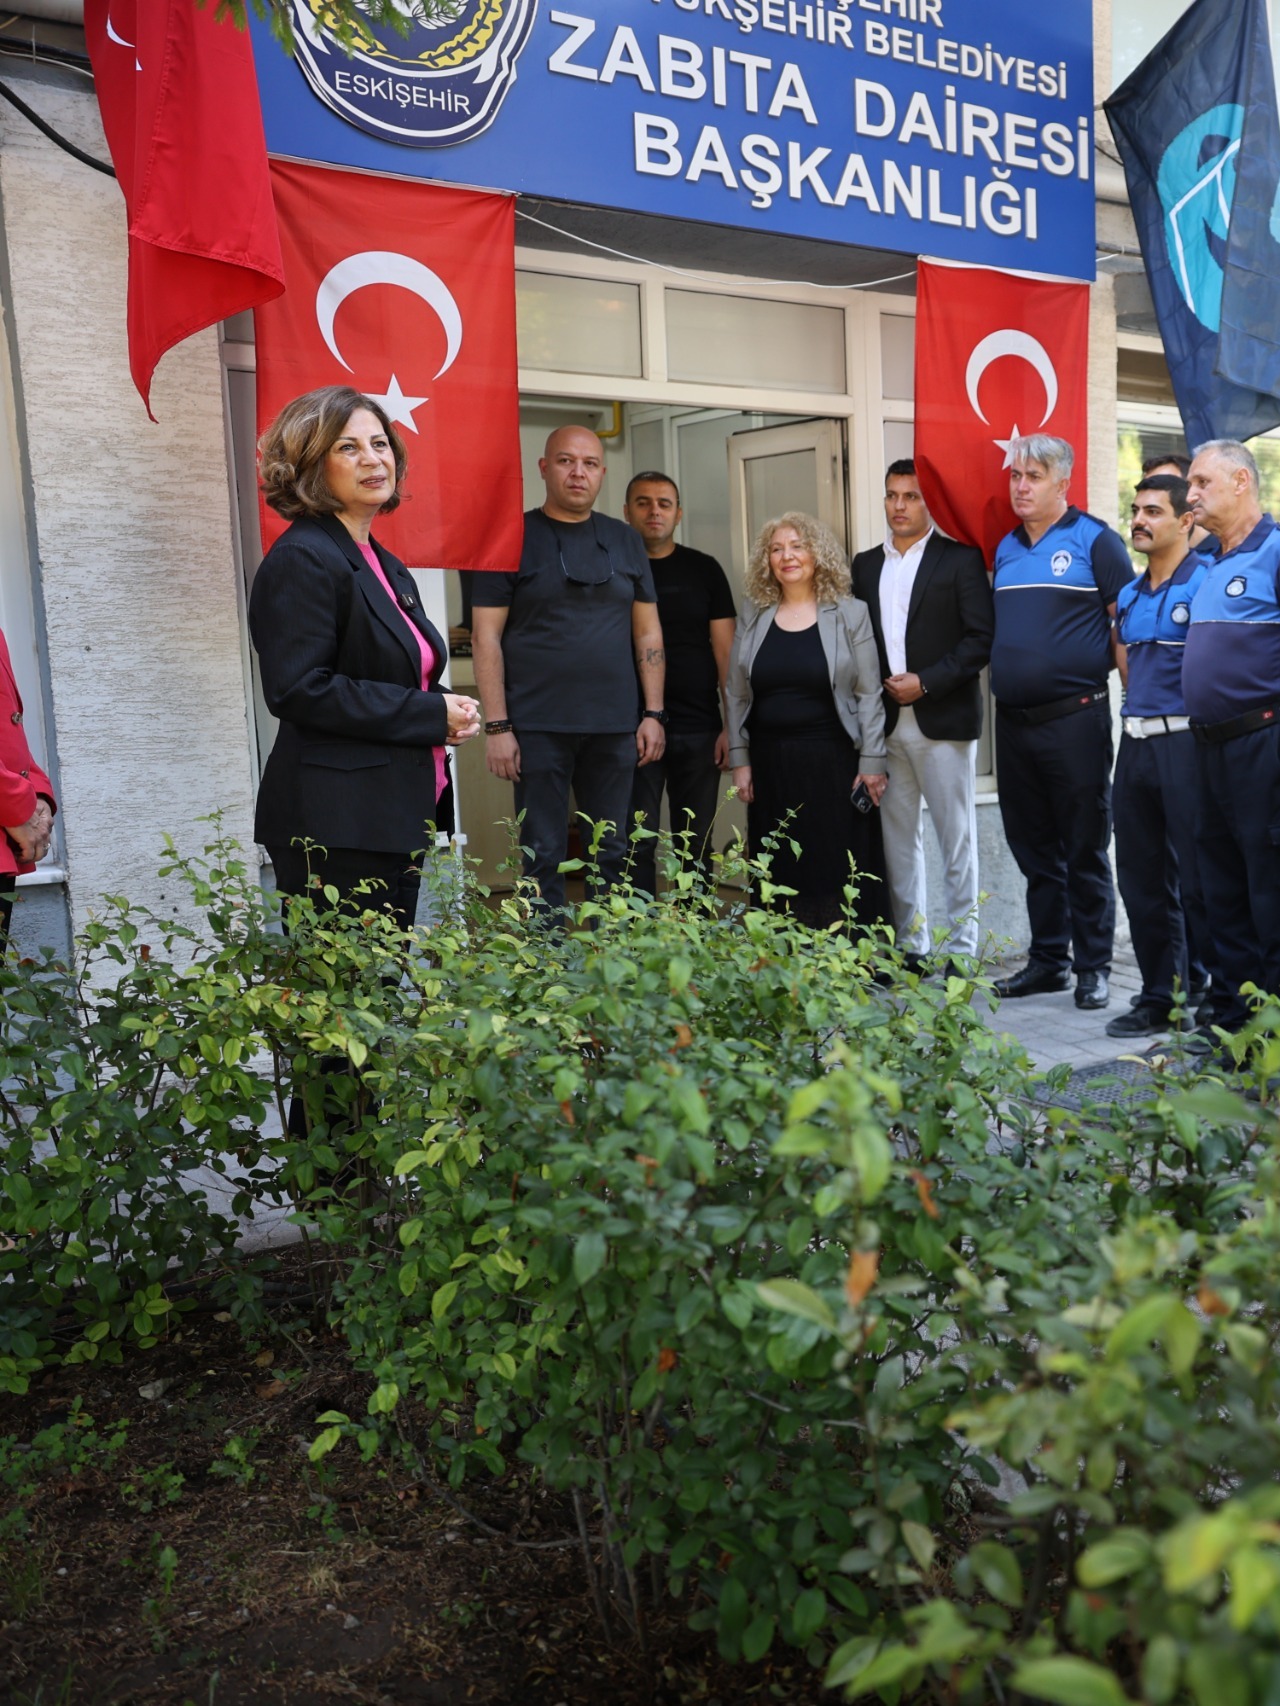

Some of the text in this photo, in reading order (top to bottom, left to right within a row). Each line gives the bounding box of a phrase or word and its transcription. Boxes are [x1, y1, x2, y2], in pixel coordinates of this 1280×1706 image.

[334, 70, 472, 116] ESKİŞEHİR
[548, 10, 1090, 180] ZABITA DAİRESİ
[865, 20, 1067, 99] BELEDİYESİ
[633, 111, 1038, 240] BAŞKANLIĞI
